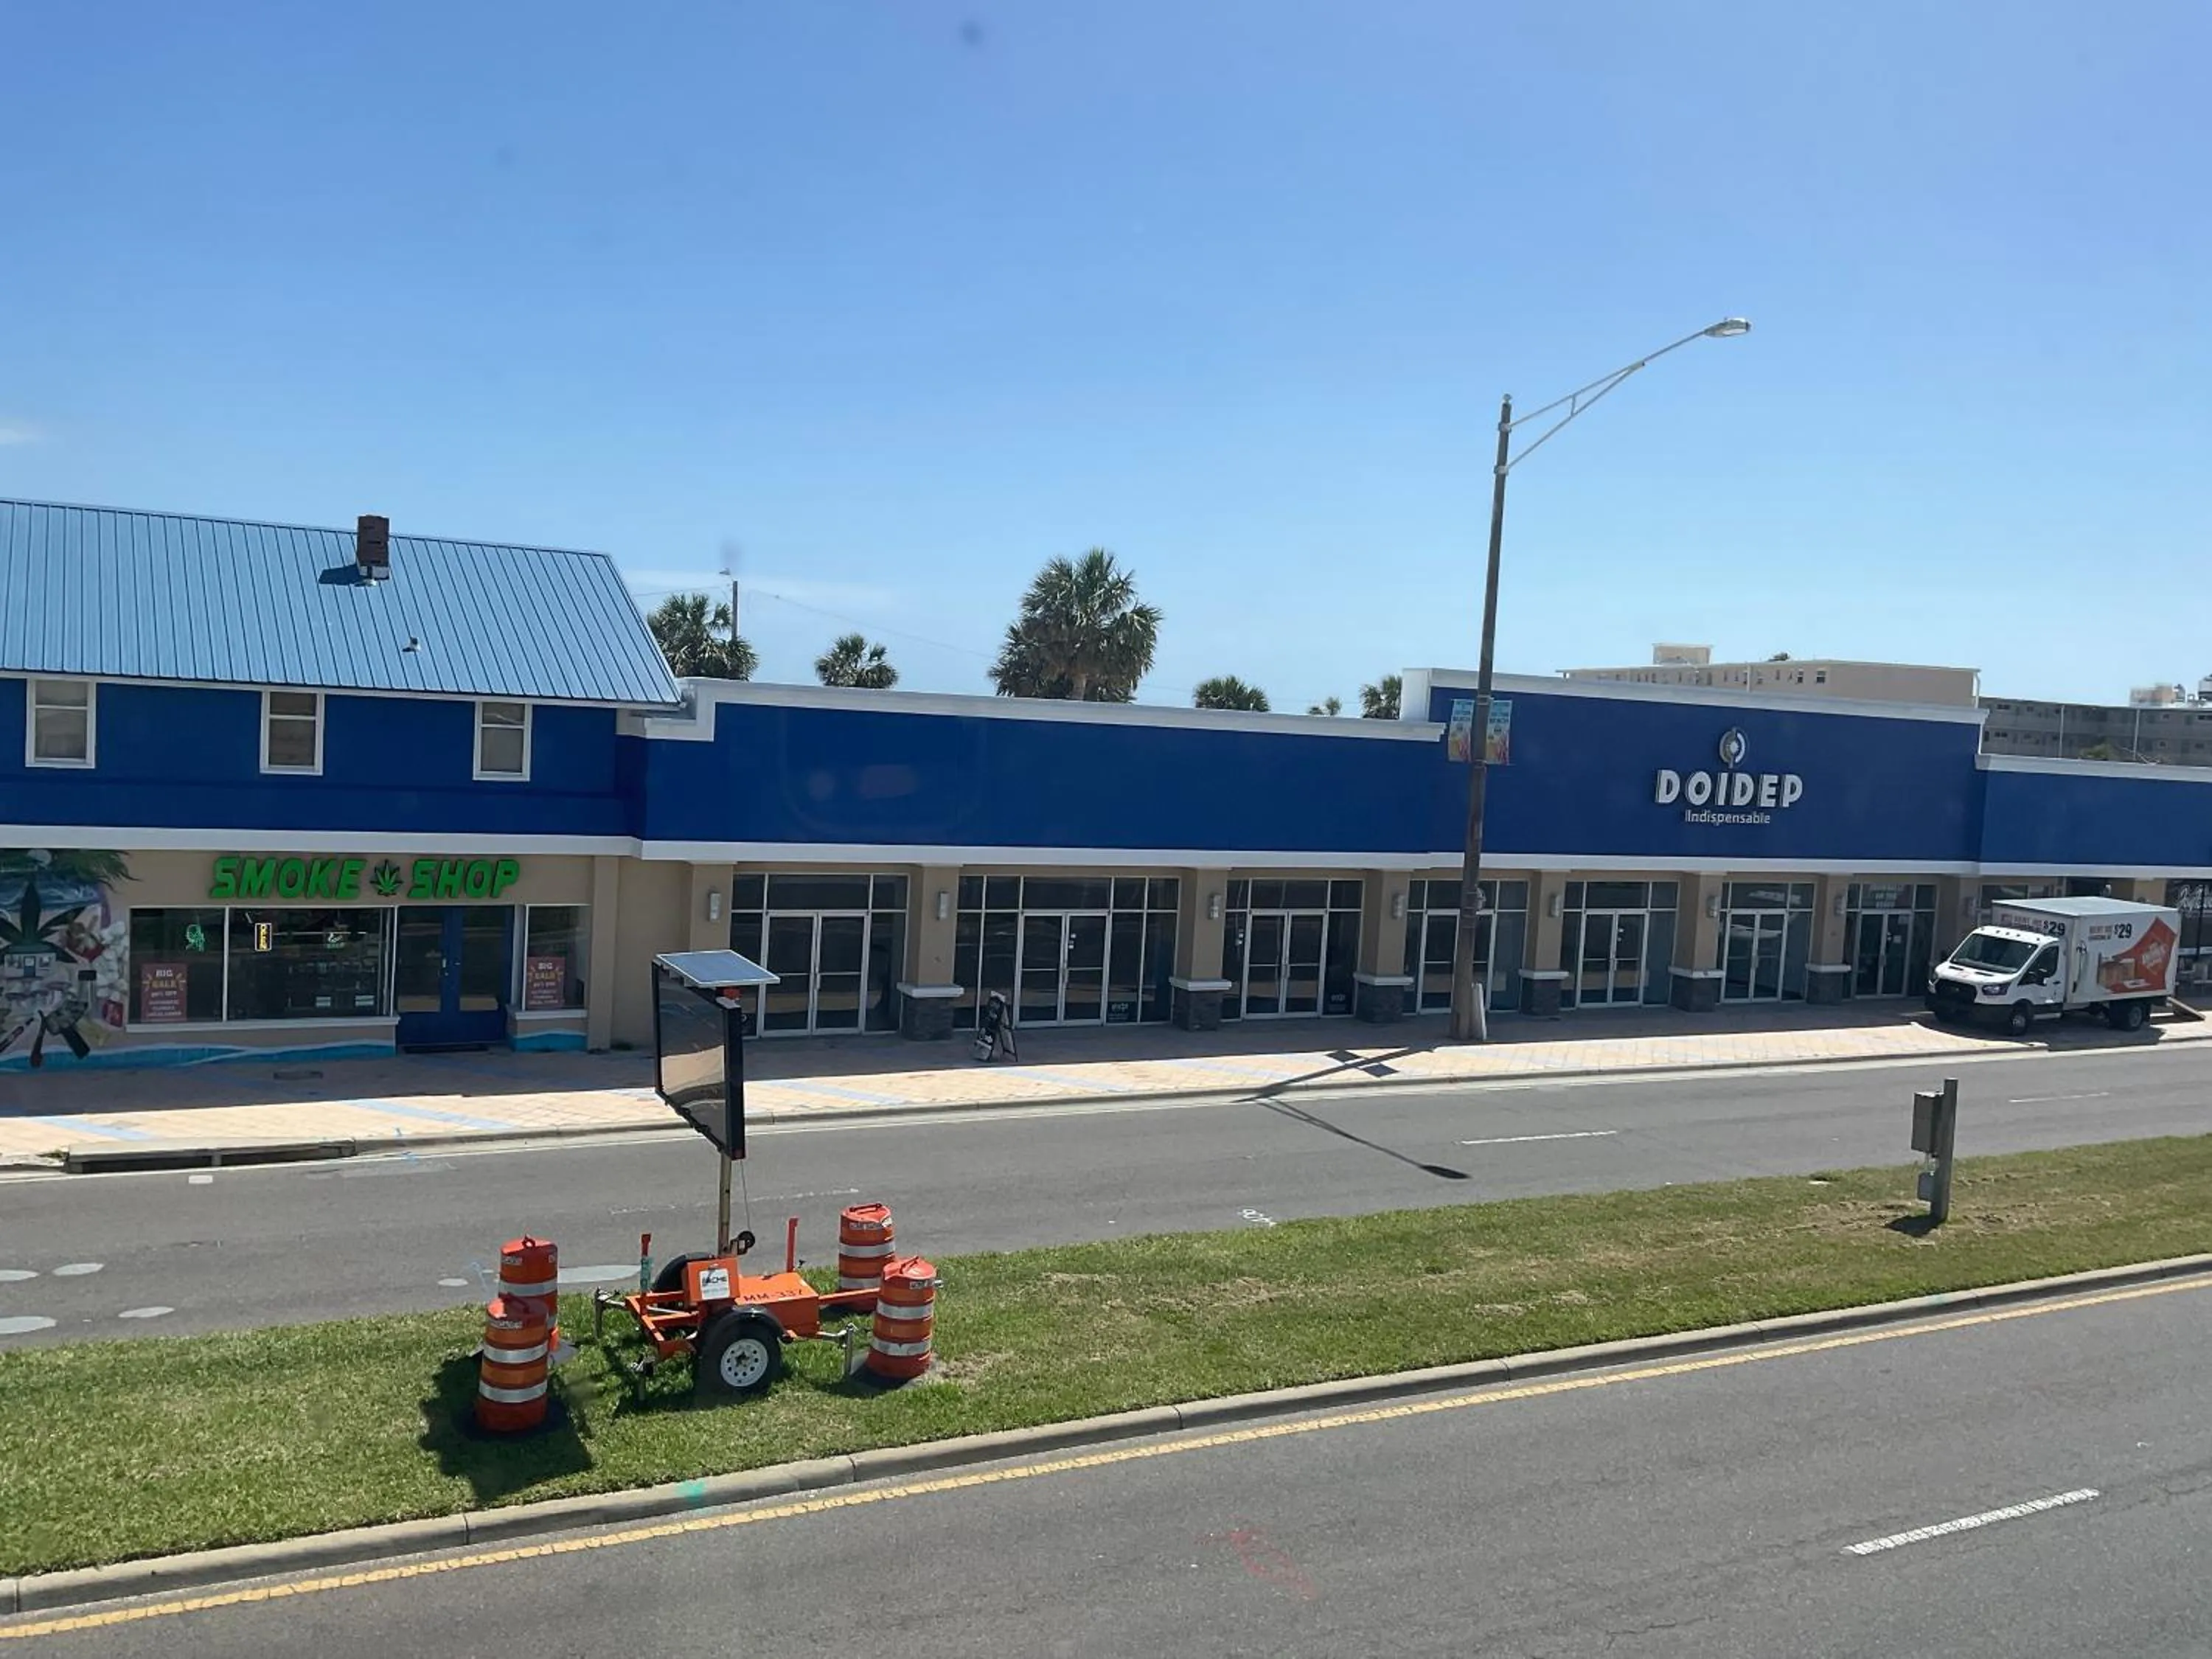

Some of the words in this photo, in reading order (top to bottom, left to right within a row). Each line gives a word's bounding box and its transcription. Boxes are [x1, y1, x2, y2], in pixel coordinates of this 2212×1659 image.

[1655, 769, 1804, 807] DOIDEP
[1685, 809, 1770, 827] Indispensable
[210, 857, 368, 899] SMOKE
[407, 858, 521, 899] SHOP
[2043, 919, 2065, 936] $29
[2114, 923, 2132, 939] $29
